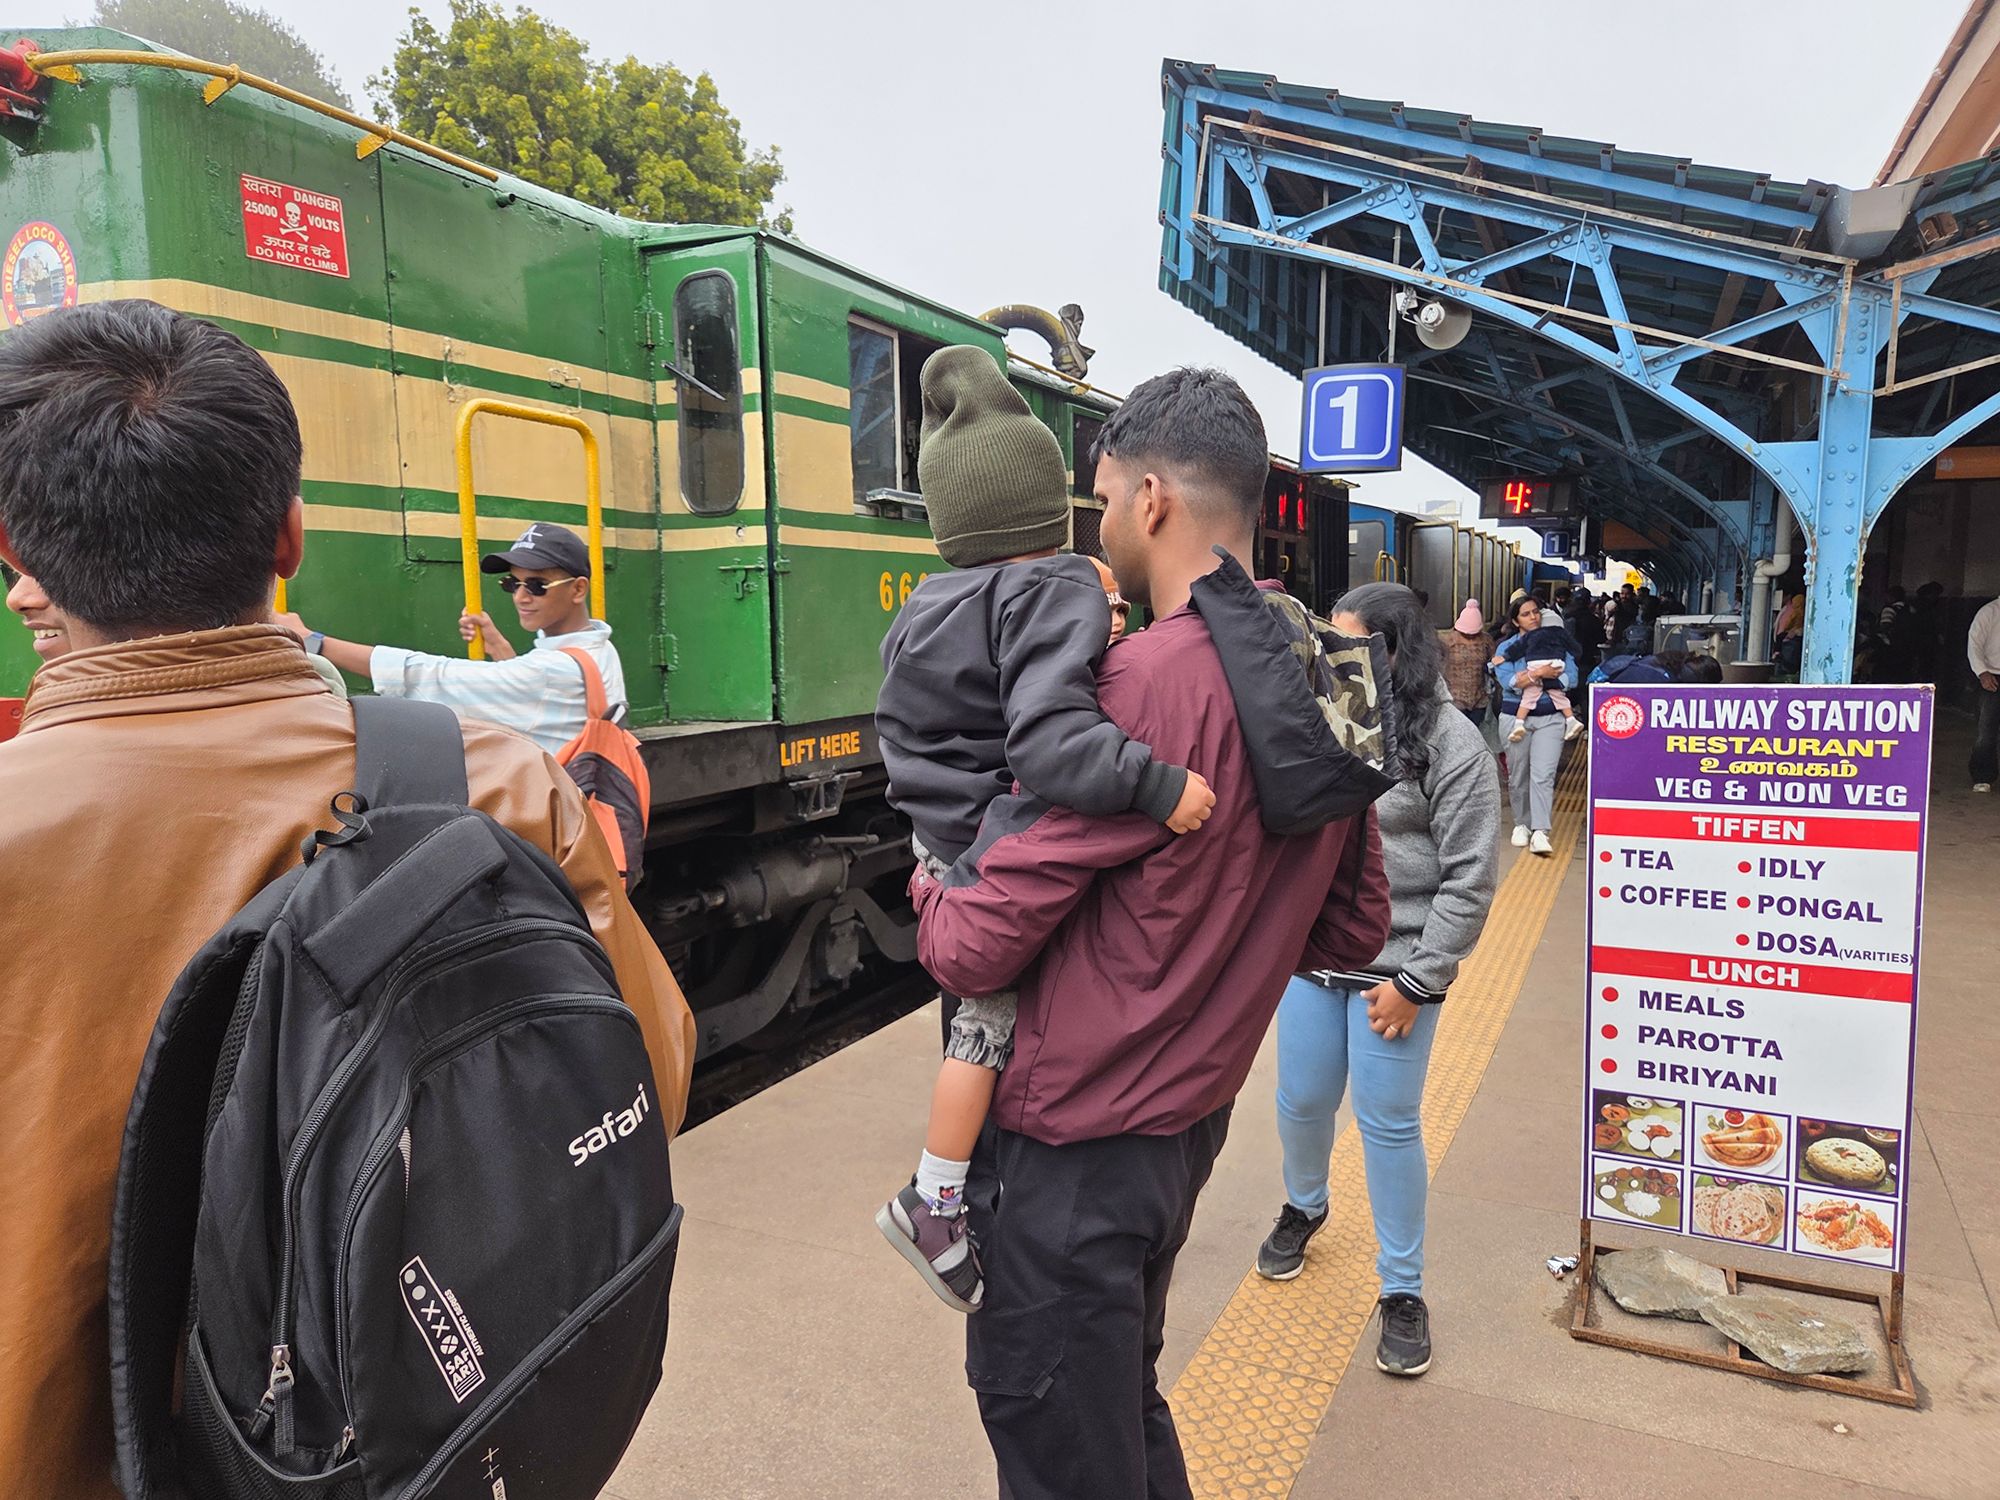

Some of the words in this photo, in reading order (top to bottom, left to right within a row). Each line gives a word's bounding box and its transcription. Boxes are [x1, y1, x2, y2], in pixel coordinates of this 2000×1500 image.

[241, 177, 282, 199] खतरा
[293, 190, 340, 213] DANGER
[244, 200, 278, 218] 25000
[306, 214, 340, 233] VOLTS
[261, 234, 295, 251] ऊपर
[297, 242, 309, 254] न
[5, 237, 26, 293] DIESEL
[25, 226, 55, 242] LOCO
[56, 240, 75, 286] SHED
[255, 246, 274, 258] DO
[276, 250, 301, 264] NOT
[303, 257, 339, 272] CLIMB
[1329, 385, 1359, 449] 1
[1550, 534, 1560, 552] 1
[879, 571, 929, 612] 66
[1650, 699, 1778, 729] RAILWAY
[1786, 699, 1920, 732] STATION
[780, 737, 816, 767] LIFT
[820, 731, 860, 760] HERE
[1666, 735, 1898, 758] RESTAURANT
[1699, 757, 1858, 777] உணவகம்
[1655, 777, 1712, 799] VEG
[1723, 780, 1747, 800] &
[1759, 781, 1831, 804] NON
[1843, 784, 1908, 807] VEG
[1692, 816, 1805, 841] TIFFEN
[1620, 849, 1674, 871] TEA
[1759, 857, 1826, 880] IDLY
[1619, 885, 1727, 911] COFFEE
[1757, 894, 1883, 923] PONGAL
[1690, 959, 1799, 988] LUNCH
[1638, 990, 1745, 1019] MEALS
[1637, 1025, 1784, 1061] PAROTTA
[1637, 1060, 1777, 1096] BIRIYANI
[568, 1083, 650, 1167] safari
[460, 1314, 484, 1356] AUTHENTIC
[445, 1347, 470, 1375] SAF
[452, 1360, 476, 1387] ARI
